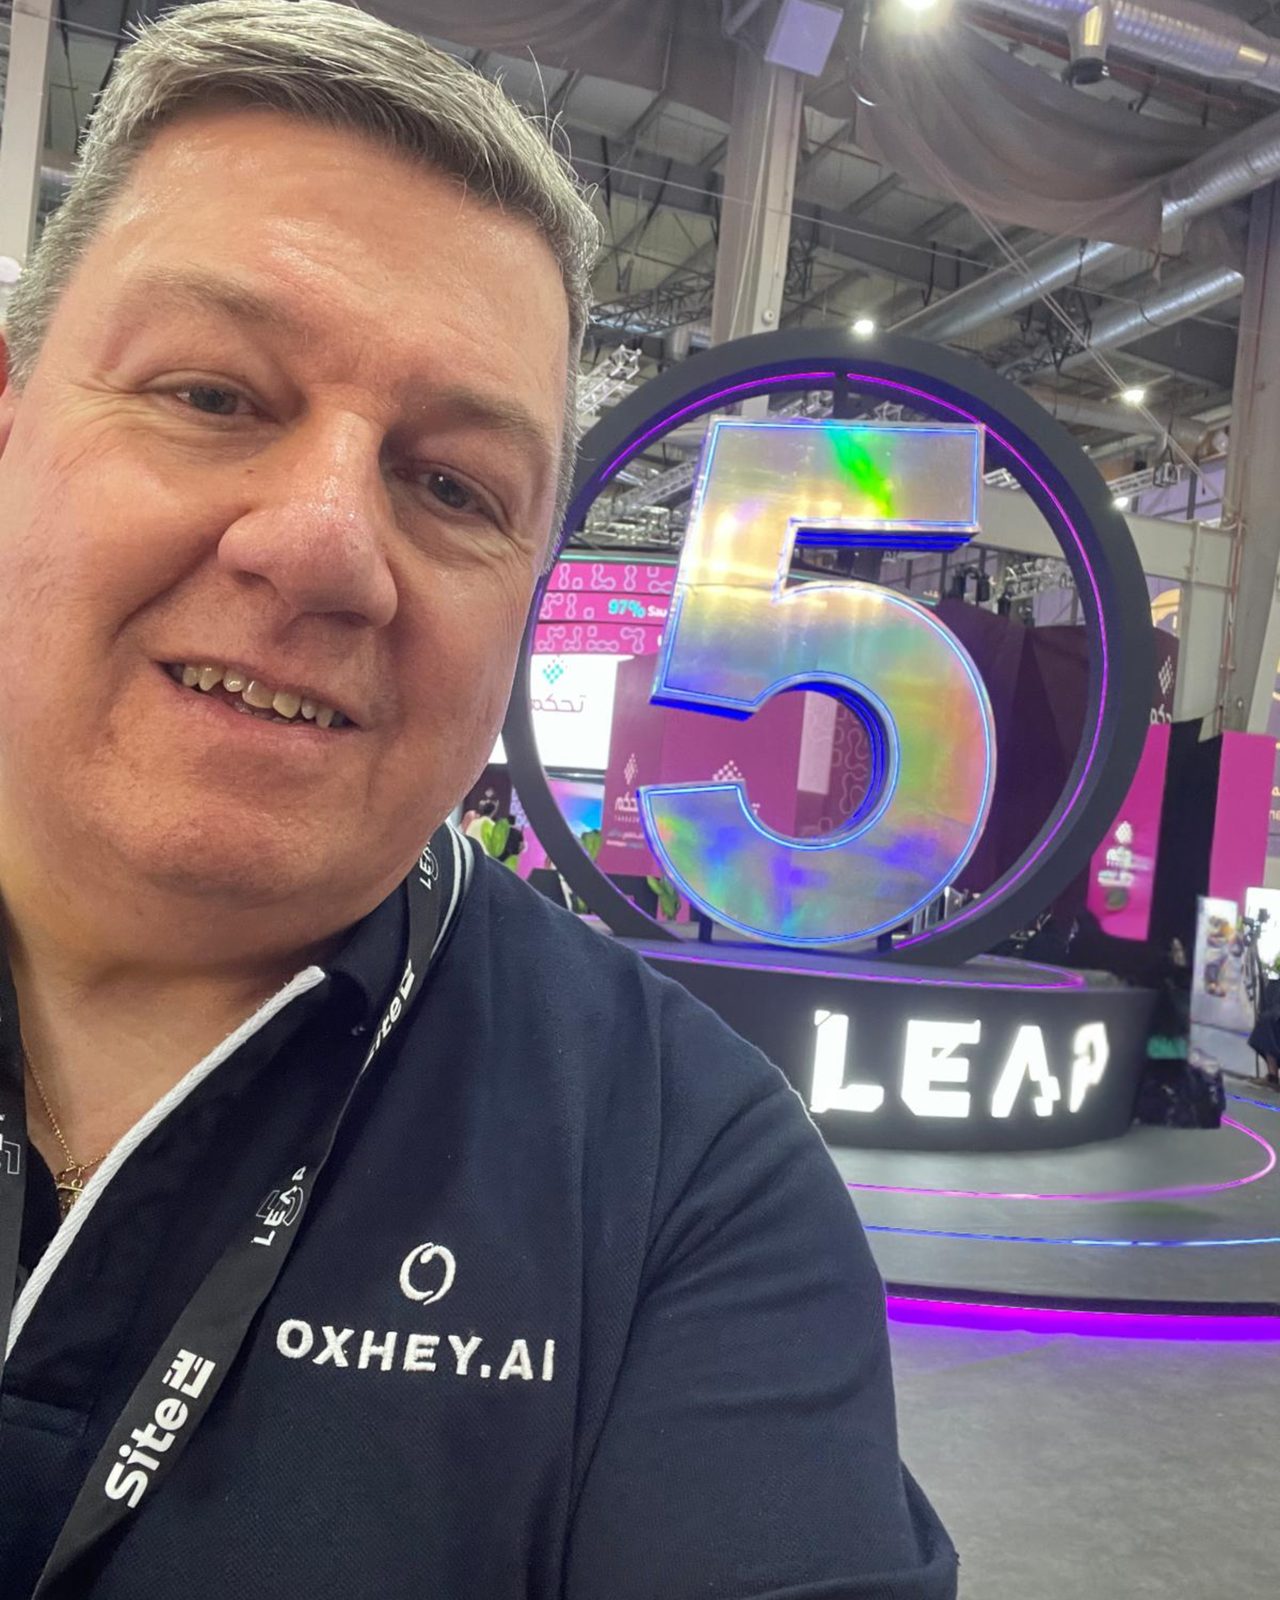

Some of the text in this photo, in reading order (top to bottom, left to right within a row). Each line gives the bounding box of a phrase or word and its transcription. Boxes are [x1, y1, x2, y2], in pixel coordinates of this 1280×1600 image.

[608, 598, 668, 618] 97% Sau
[637, 415, 997, 949] 5
[419, 841, 432, 890] LEA
[809, 1009, 1109, 1118] LEAP
[251, 1165, 307, 1246] LEAP
[275, 1318, 556, 1382] OXHEY.AI
[104, 1397, 189, 1509] Site
